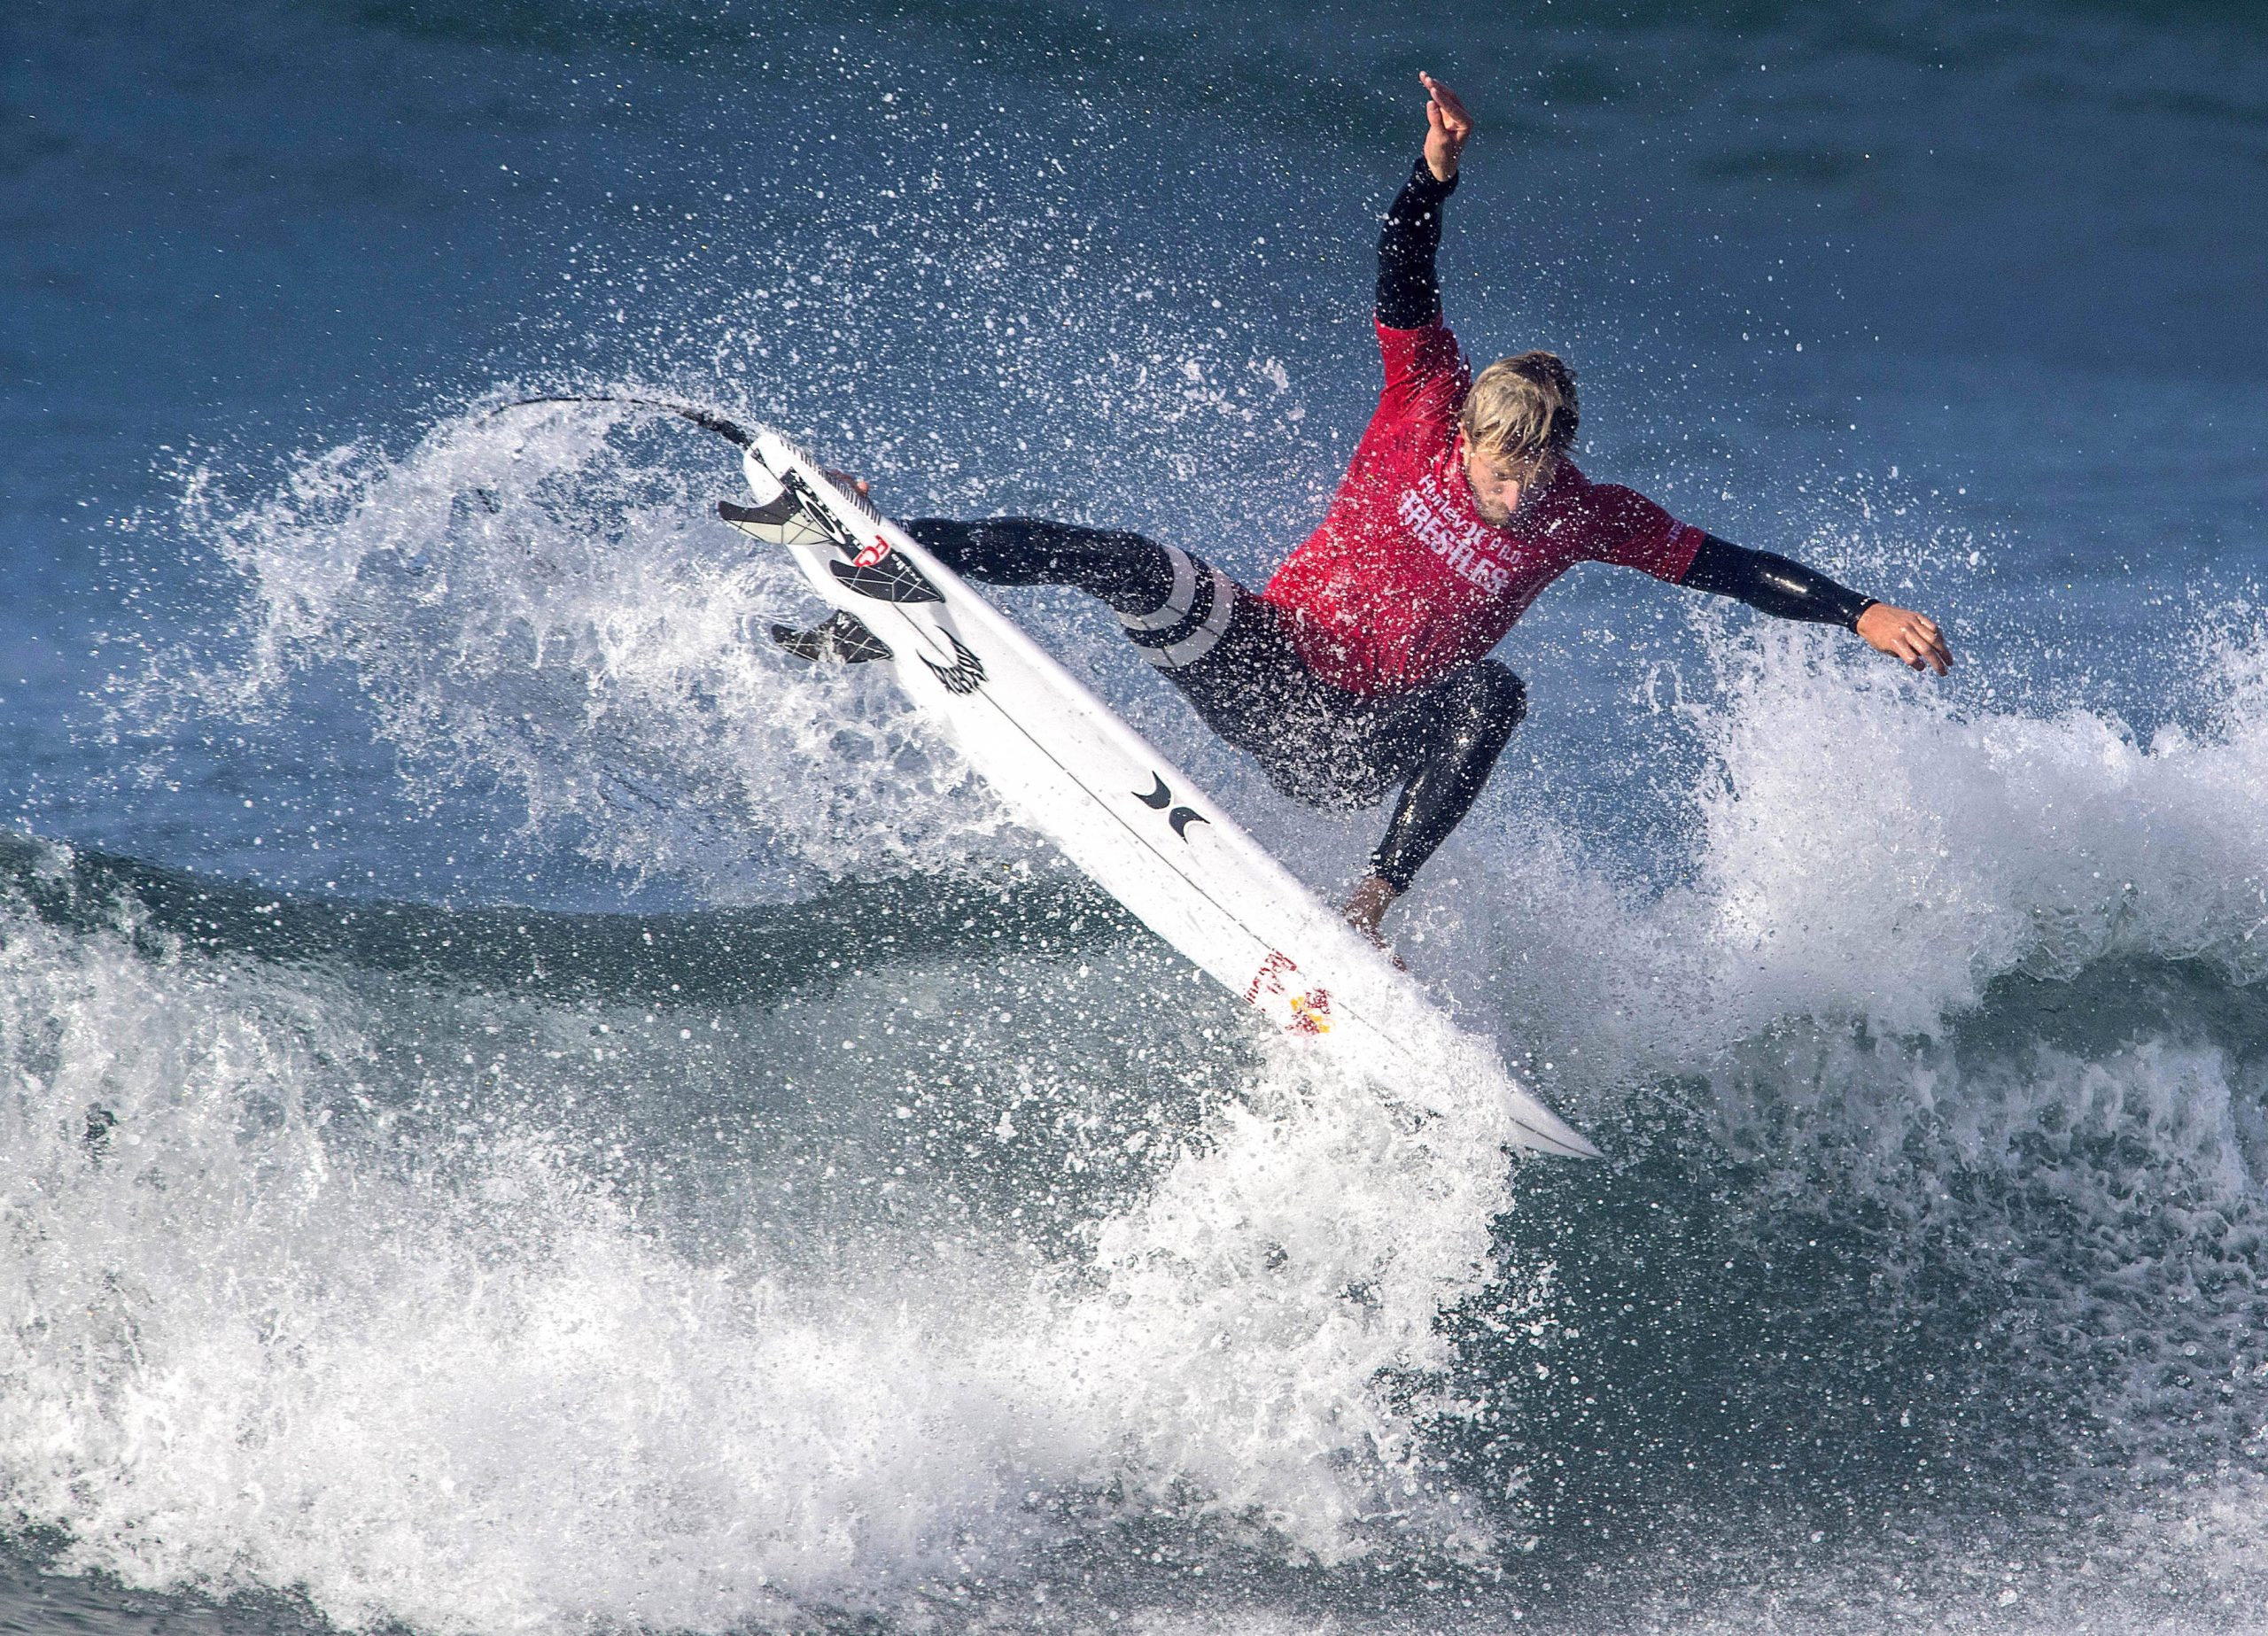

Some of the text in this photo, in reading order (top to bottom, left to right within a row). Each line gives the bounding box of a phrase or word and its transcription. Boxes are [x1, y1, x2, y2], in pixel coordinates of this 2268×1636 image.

[791, 471, 865, 550] OAKLEY
[1418, 473, 1523, 565] Hurley PRO
